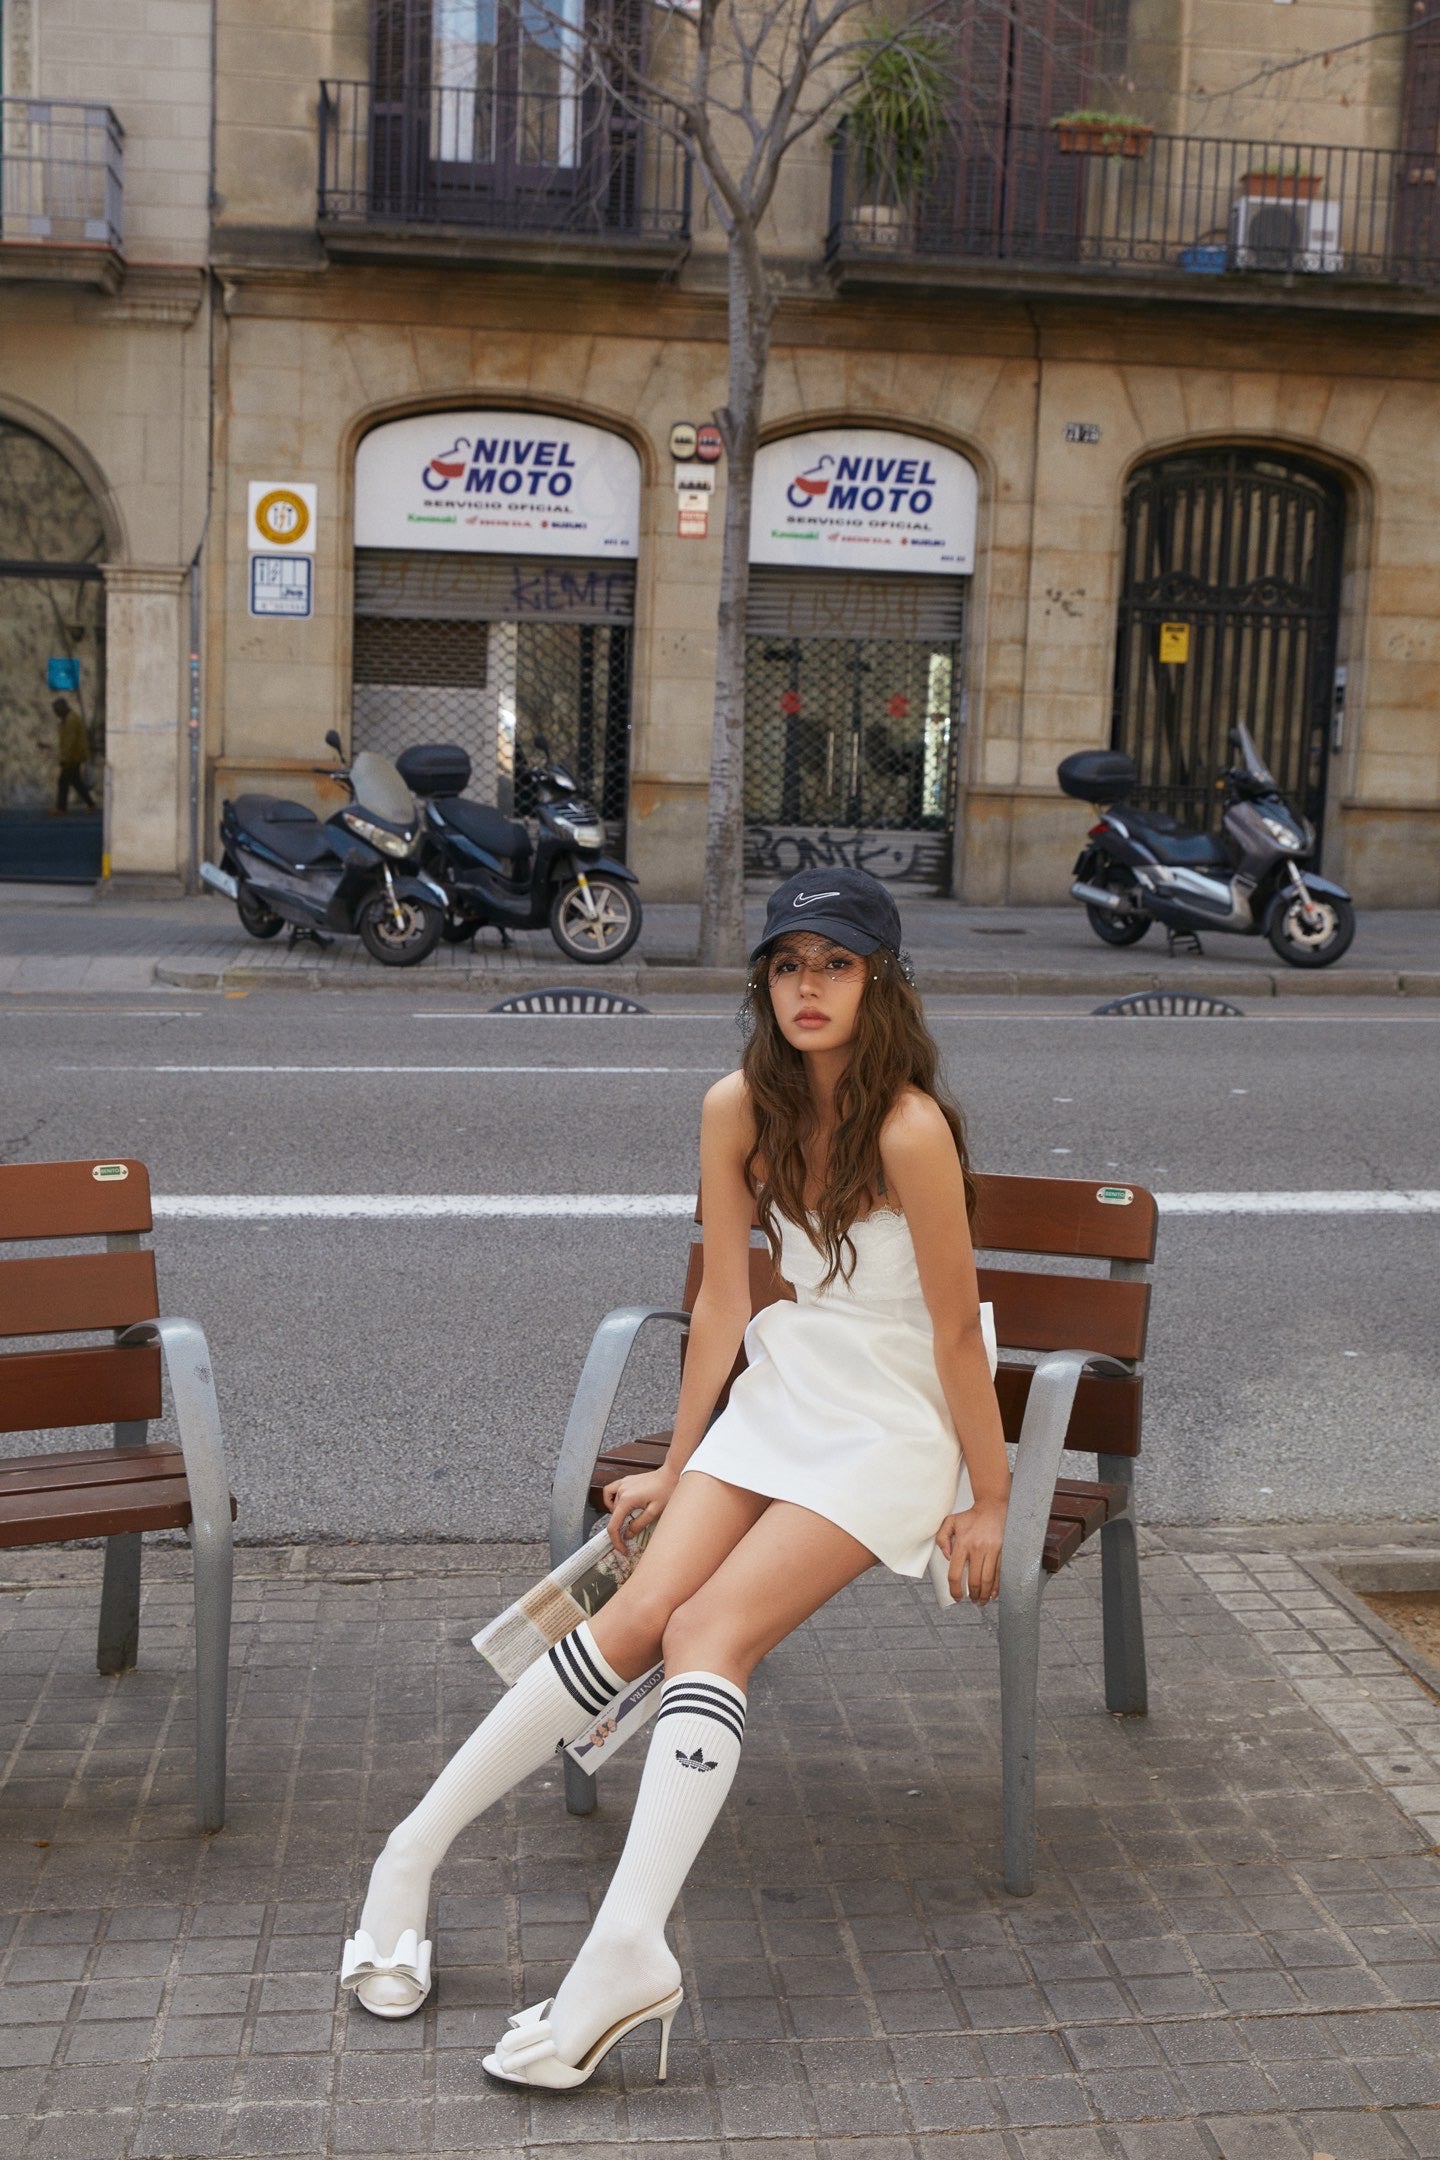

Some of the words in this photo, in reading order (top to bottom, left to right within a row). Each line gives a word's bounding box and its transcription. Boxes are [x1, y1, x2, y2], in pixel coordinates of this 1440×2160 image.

[472, 438, 575, 467] NIVEL
[464, 468, 572, 497] MOTO
[835, 455, 936, 485] NIVEL
[423, 499, 502, 510] SERVICIO
[507, 503, 574, 514] OFICIAL
[828, 485, 932, 514] MOTO
[786, 515, 863, 528] SERVICIO
[868, 520, 932, 532] OFICIAL
[100, 1167, 120, 1175] BENITO
[1105, 1190, 1125, 1198] BENITO
[630, 1672, 661, 1703] CONTRA
